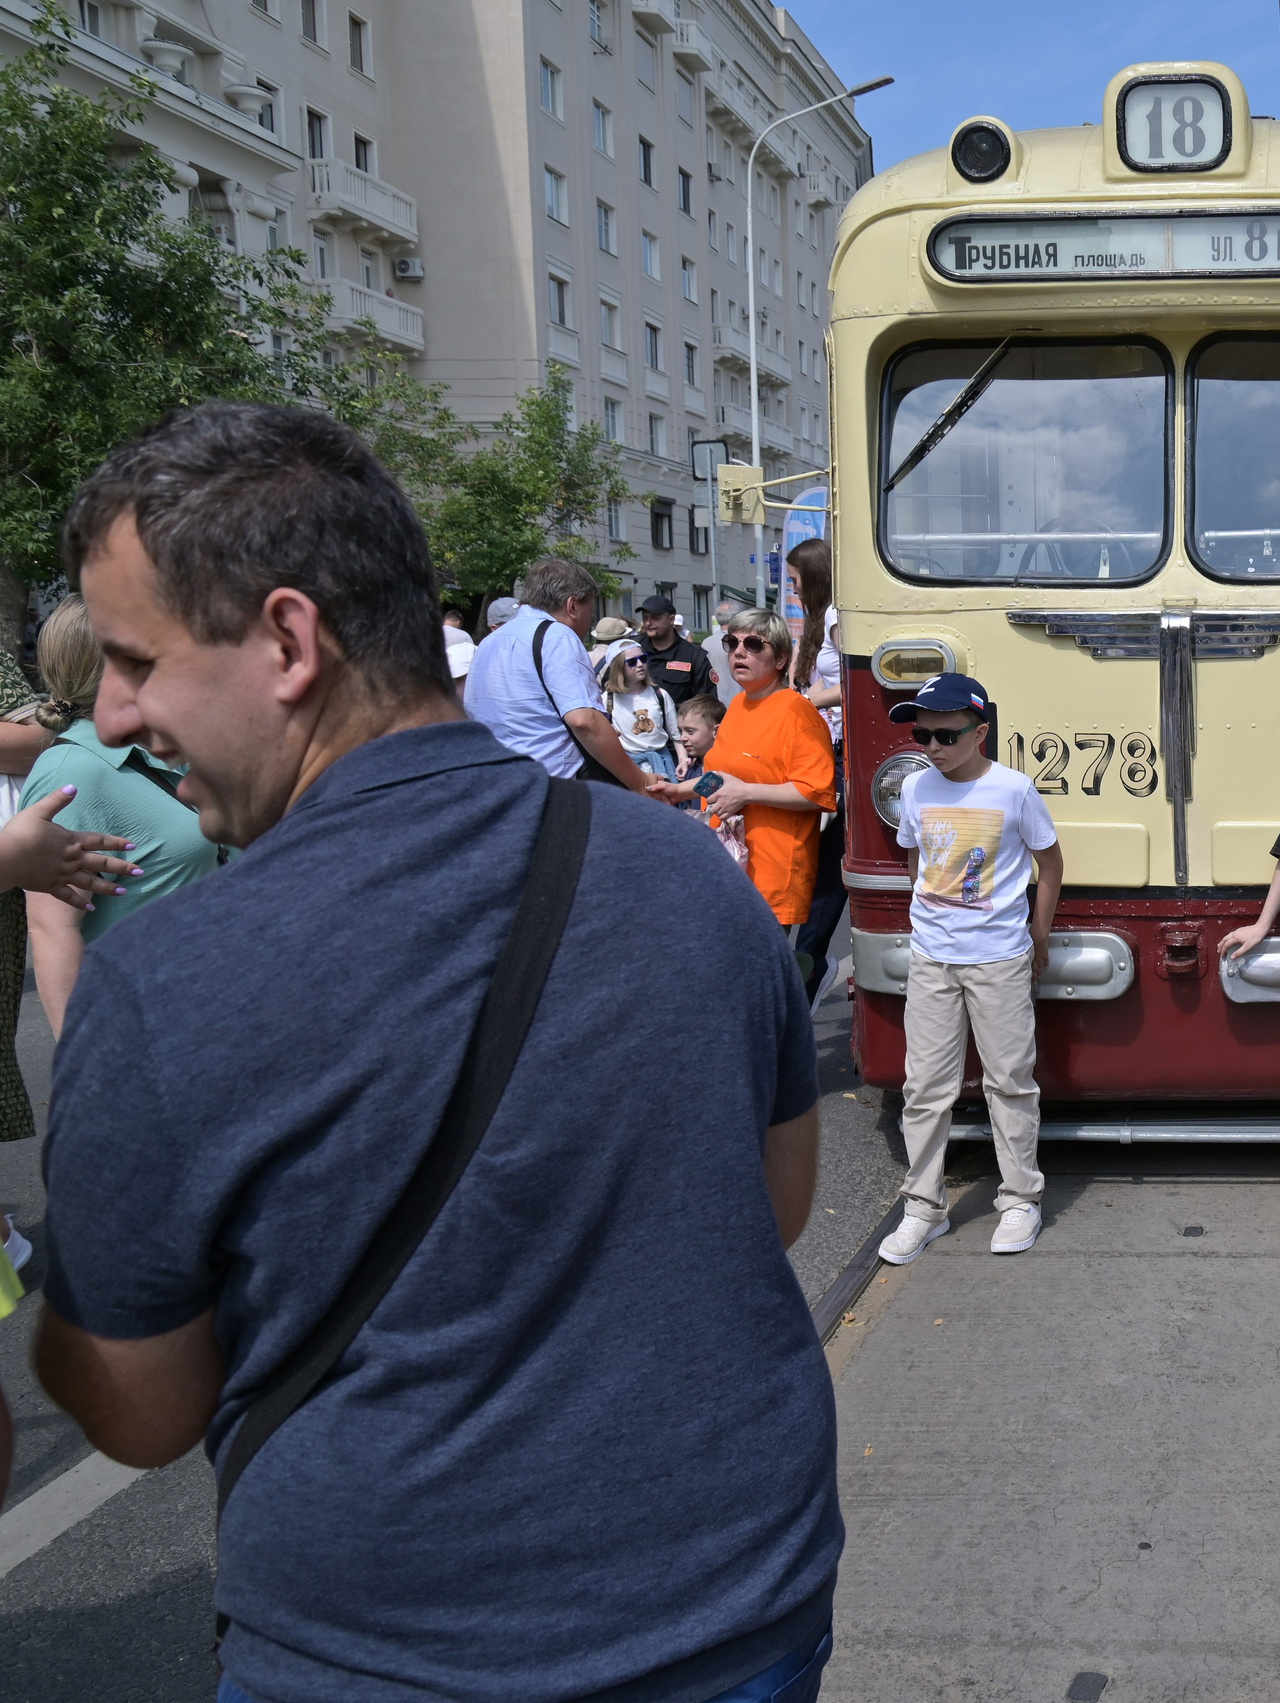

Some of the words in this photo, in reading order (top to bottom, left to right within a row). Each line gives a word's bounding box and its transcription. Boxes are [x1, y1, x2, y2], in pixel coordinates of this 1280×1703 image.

[1145, 95, 1207, 159] 18
[948, 236, 1059, 270] ТРУБНАЯ
[1244, 218, 1269, 262] 8
[917, 676, 942, 697] Z
[1007, 731, 1159, 798] 1278
